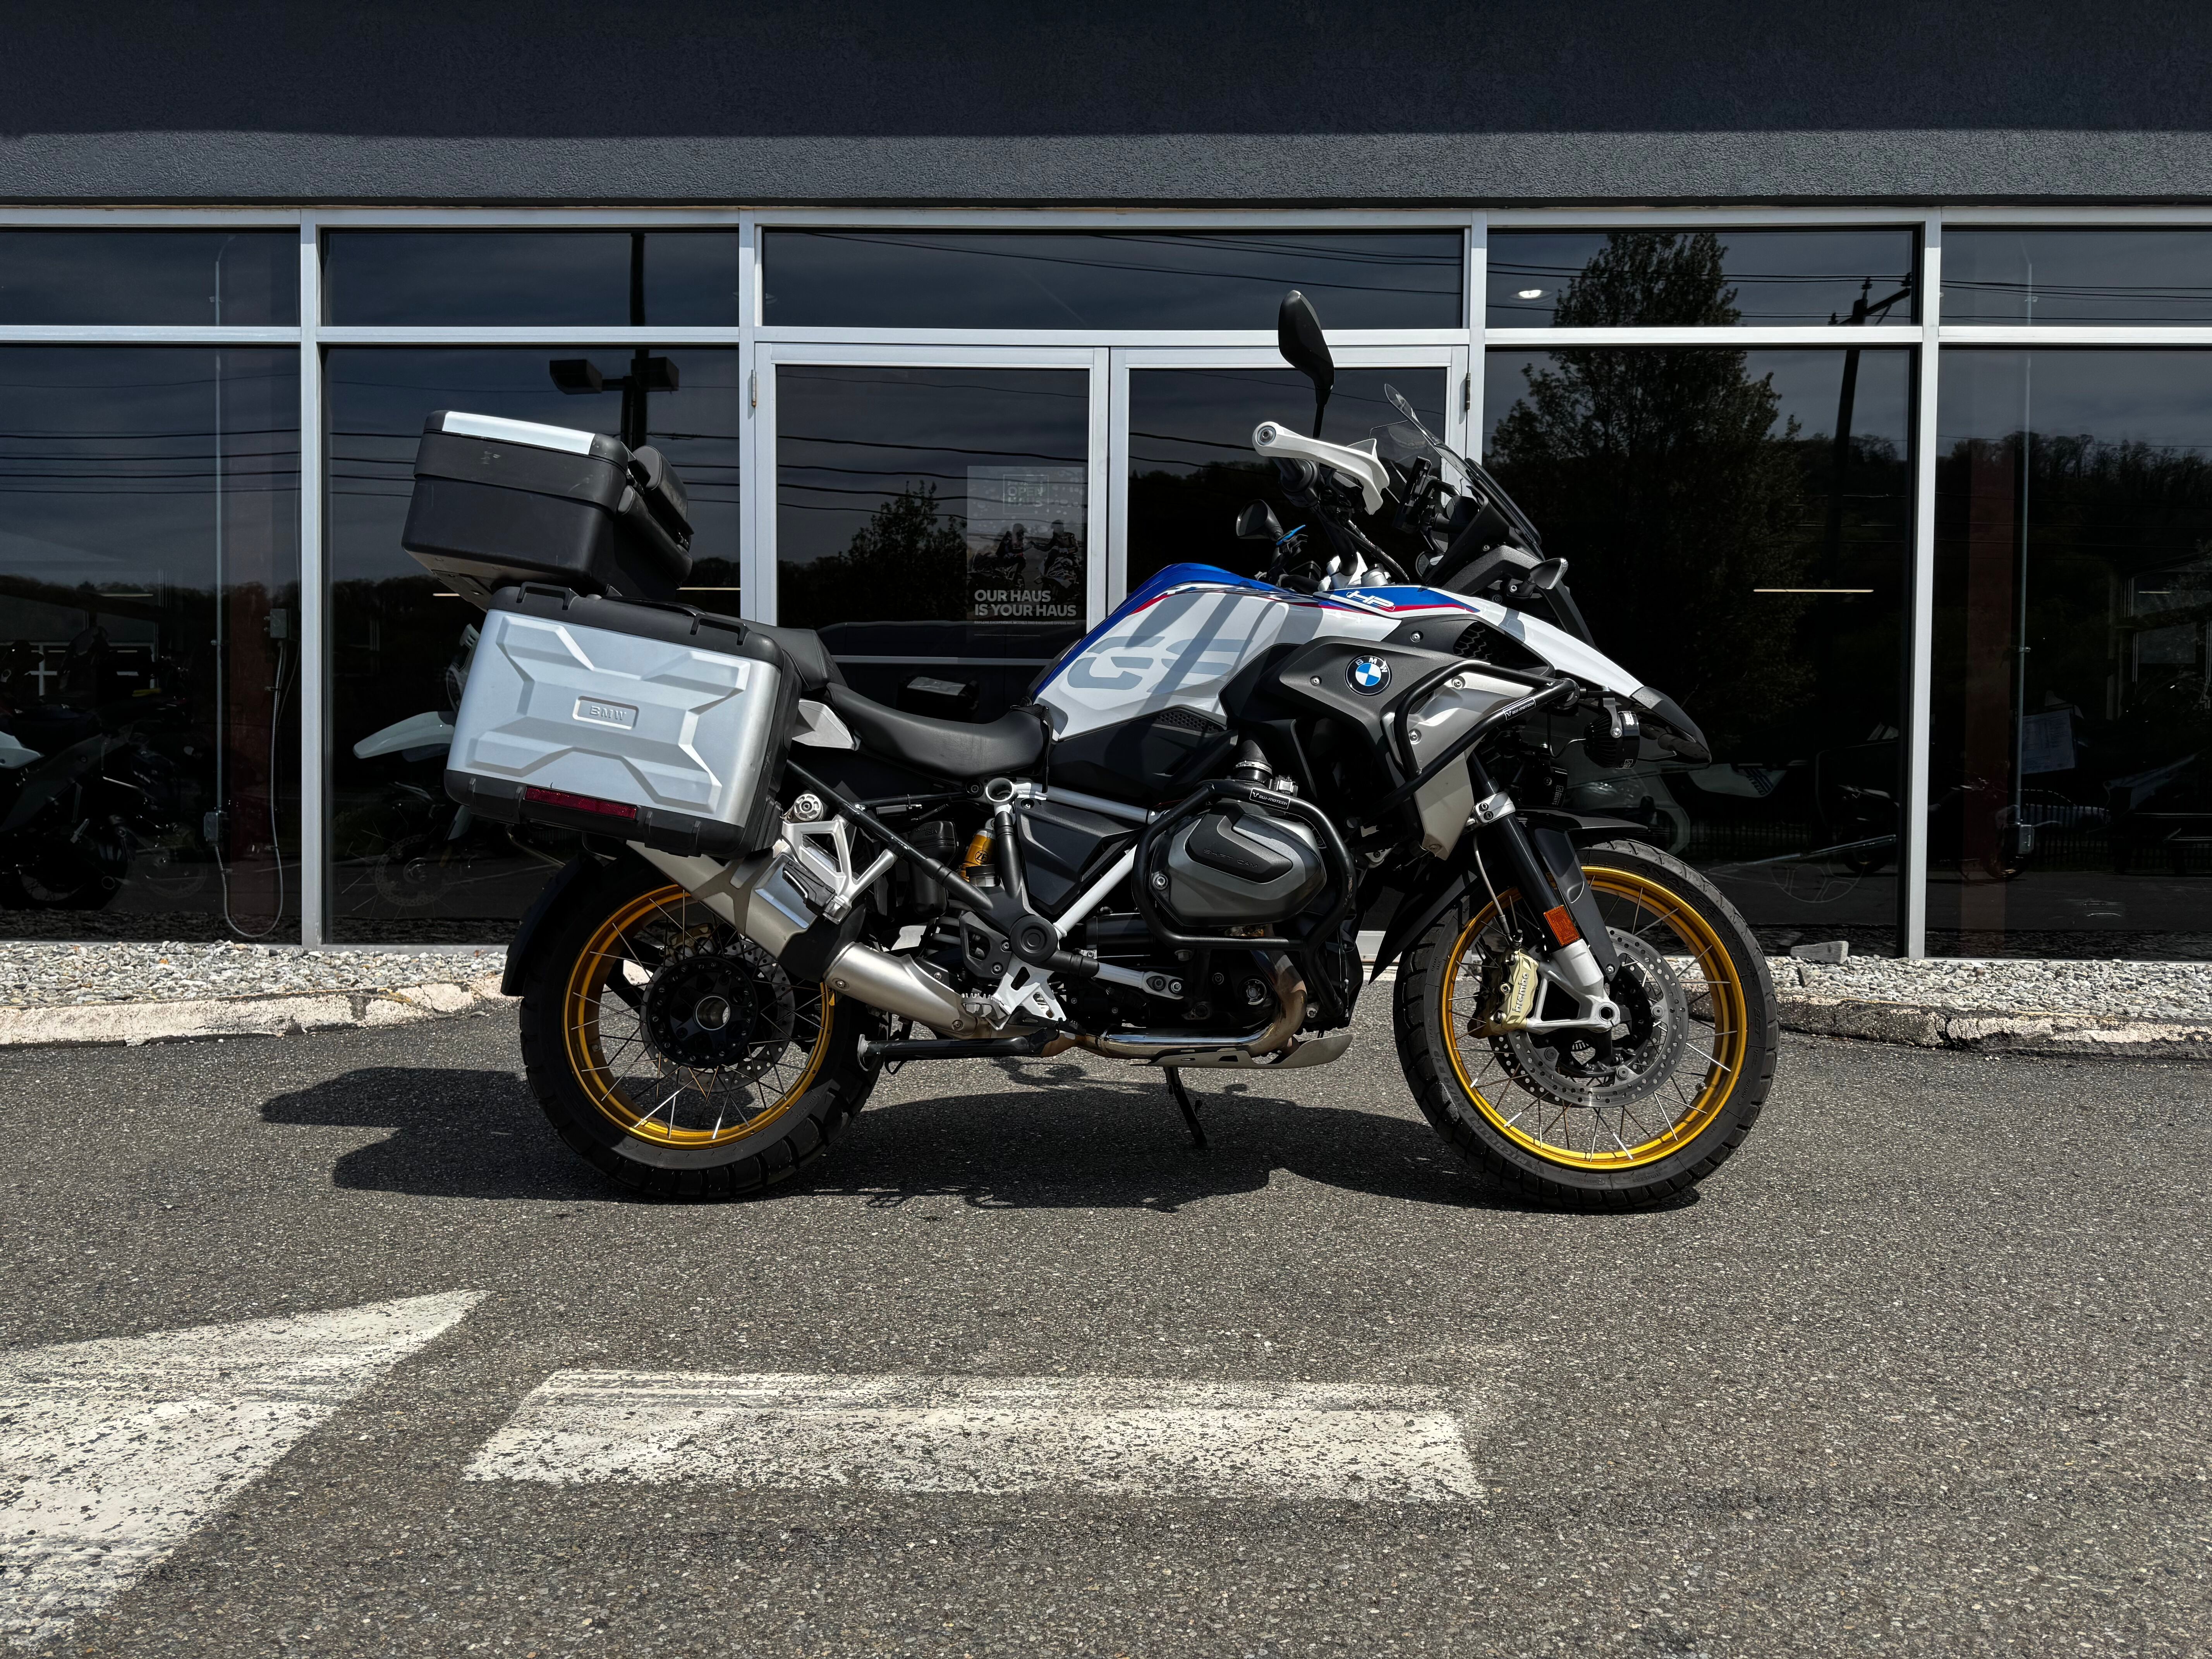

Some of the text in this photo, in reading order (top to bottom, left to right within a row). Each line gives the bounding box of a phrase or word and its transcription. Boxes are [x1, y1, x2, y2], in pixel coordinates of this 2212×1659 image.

[1008, 486, 1043, 496] OPEN
[974, 589, 1051, 602] OUR HAUS
[1346, 591, 1395, 610] HP
[975, 604, 1077, 617] IS YOUR HAUS
[1067, 636, 1254, 698] GS
[1355, 657, 1388, 673] BMW
[589, 706, 627, 721] BMW
[1259, 795, 1288, 805] SW-MOTECH
[1203, 848, 1258, 869] SHIFT CAM
[1512, 972, 1529, 1013] brembo
[1470, 1118, 1528, 1165] MICHELIN
